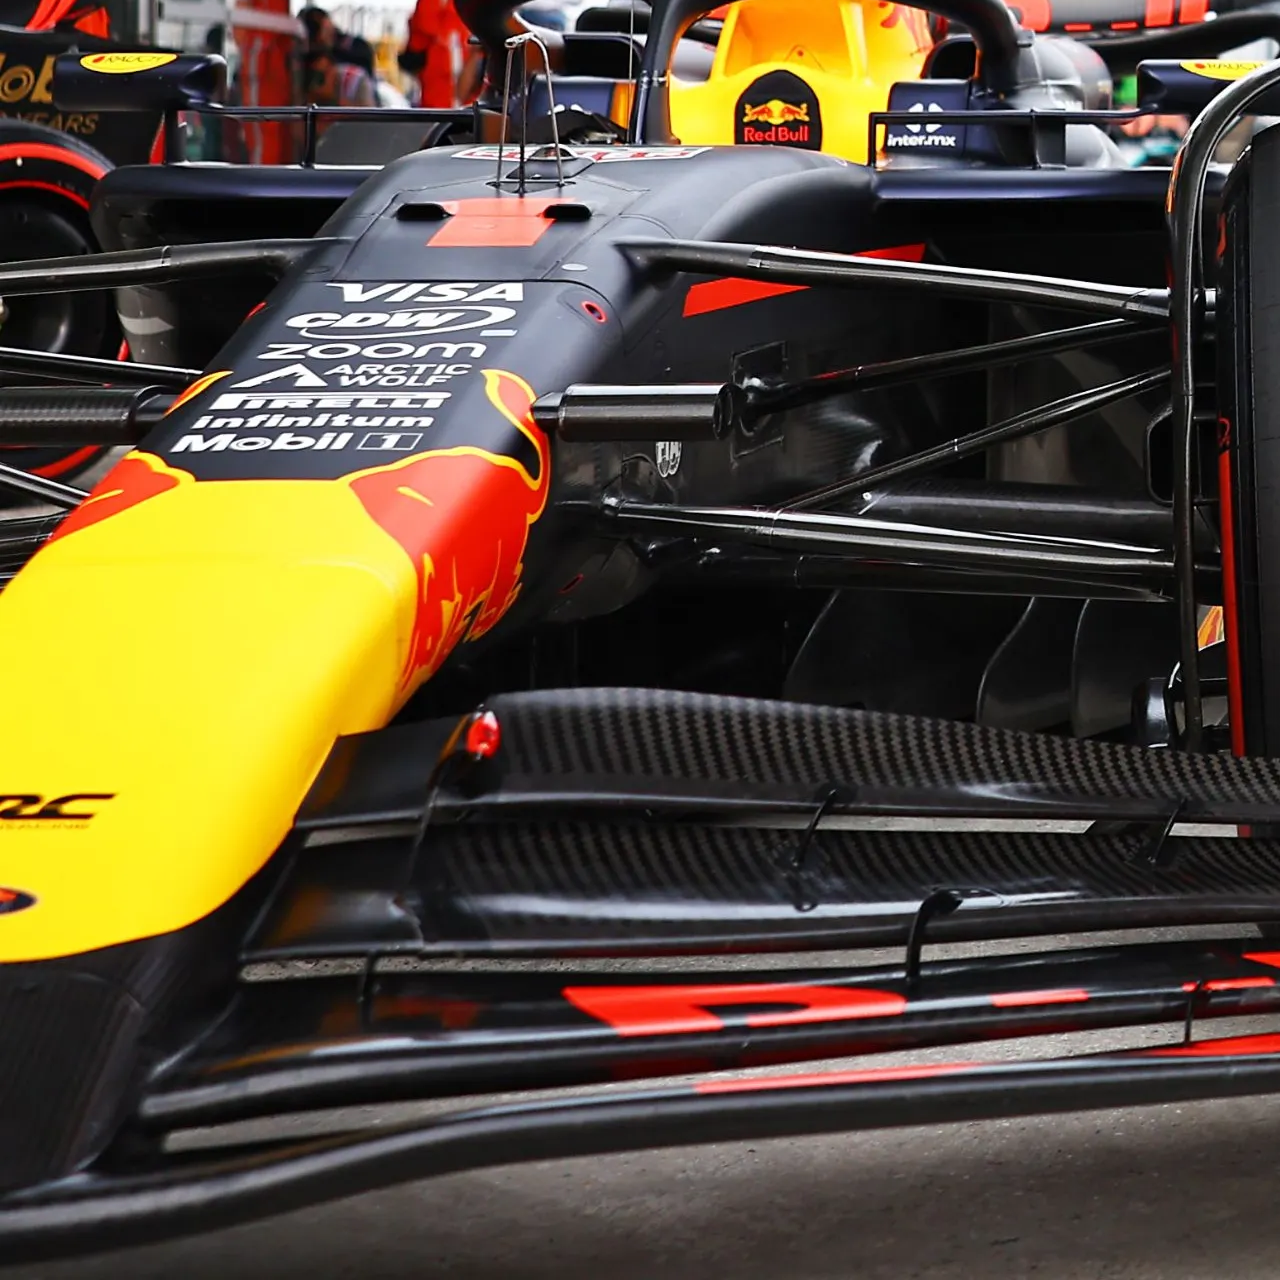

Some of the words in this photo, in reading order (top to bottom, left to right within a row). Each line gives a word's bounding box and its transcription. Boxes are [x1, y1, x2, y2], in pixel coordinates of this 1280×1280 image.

[743, 126, 775, 142] Red
[778, 126, 810, 142] Bull
[887, 133, 956, 147] inter.mx
[326, 282, 525, 303] VISA
[285, 310, 464, 329] CDW
[323, 363, 472, 376] ARCTIC
[338, 375, 453, 387] WOLF
[208, 391, 452, 410] PIRELLI
[191, 413, 435, 429] infinitum
[169, 432, 354, 453] Mobil
